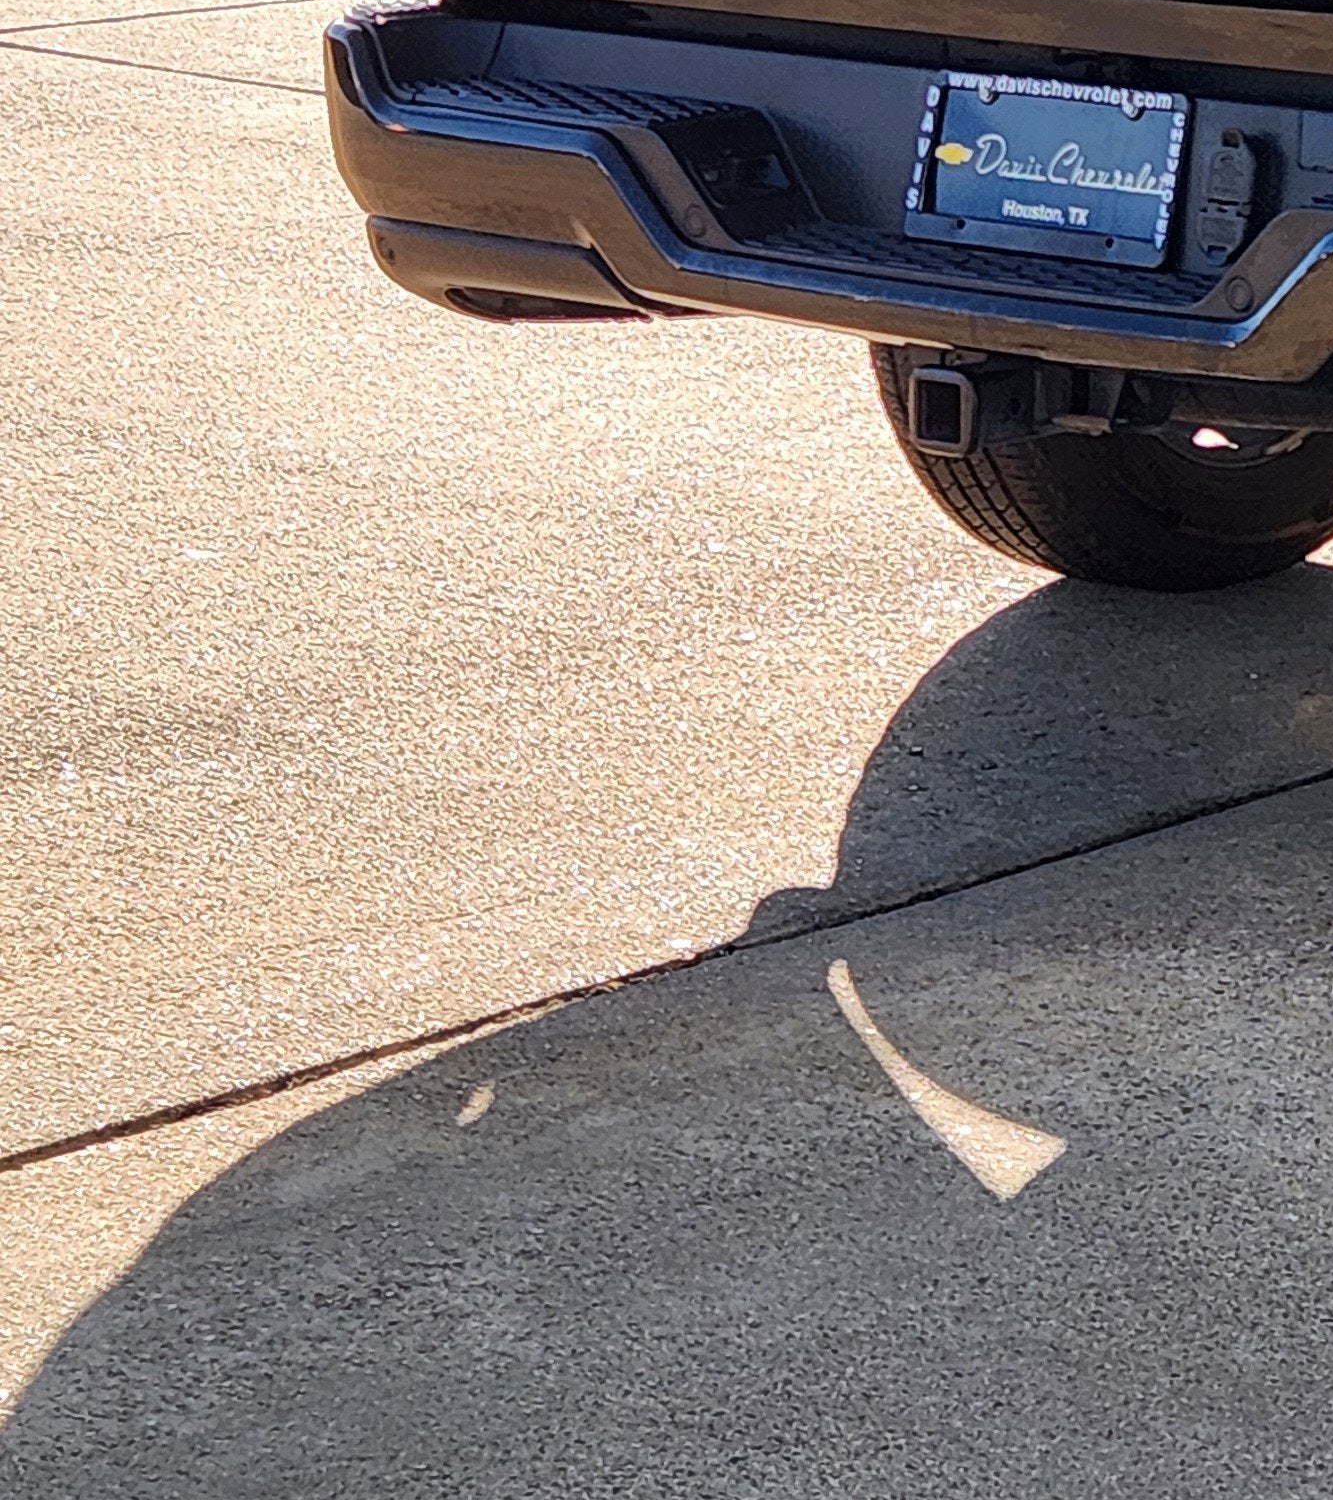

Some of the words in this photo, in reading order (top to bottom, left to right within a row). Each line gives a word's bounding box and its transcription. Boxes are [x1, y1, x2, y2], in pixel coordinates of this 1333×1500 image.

[905, 84, 941, 210] DAVIS
[975, 133, 1047, 182] Davis
[1153, 111, 1186, 250] CHEVROLET
[1002, 199, 1065, 226] Houston,
[1068, 205, 1090, 227] TX
